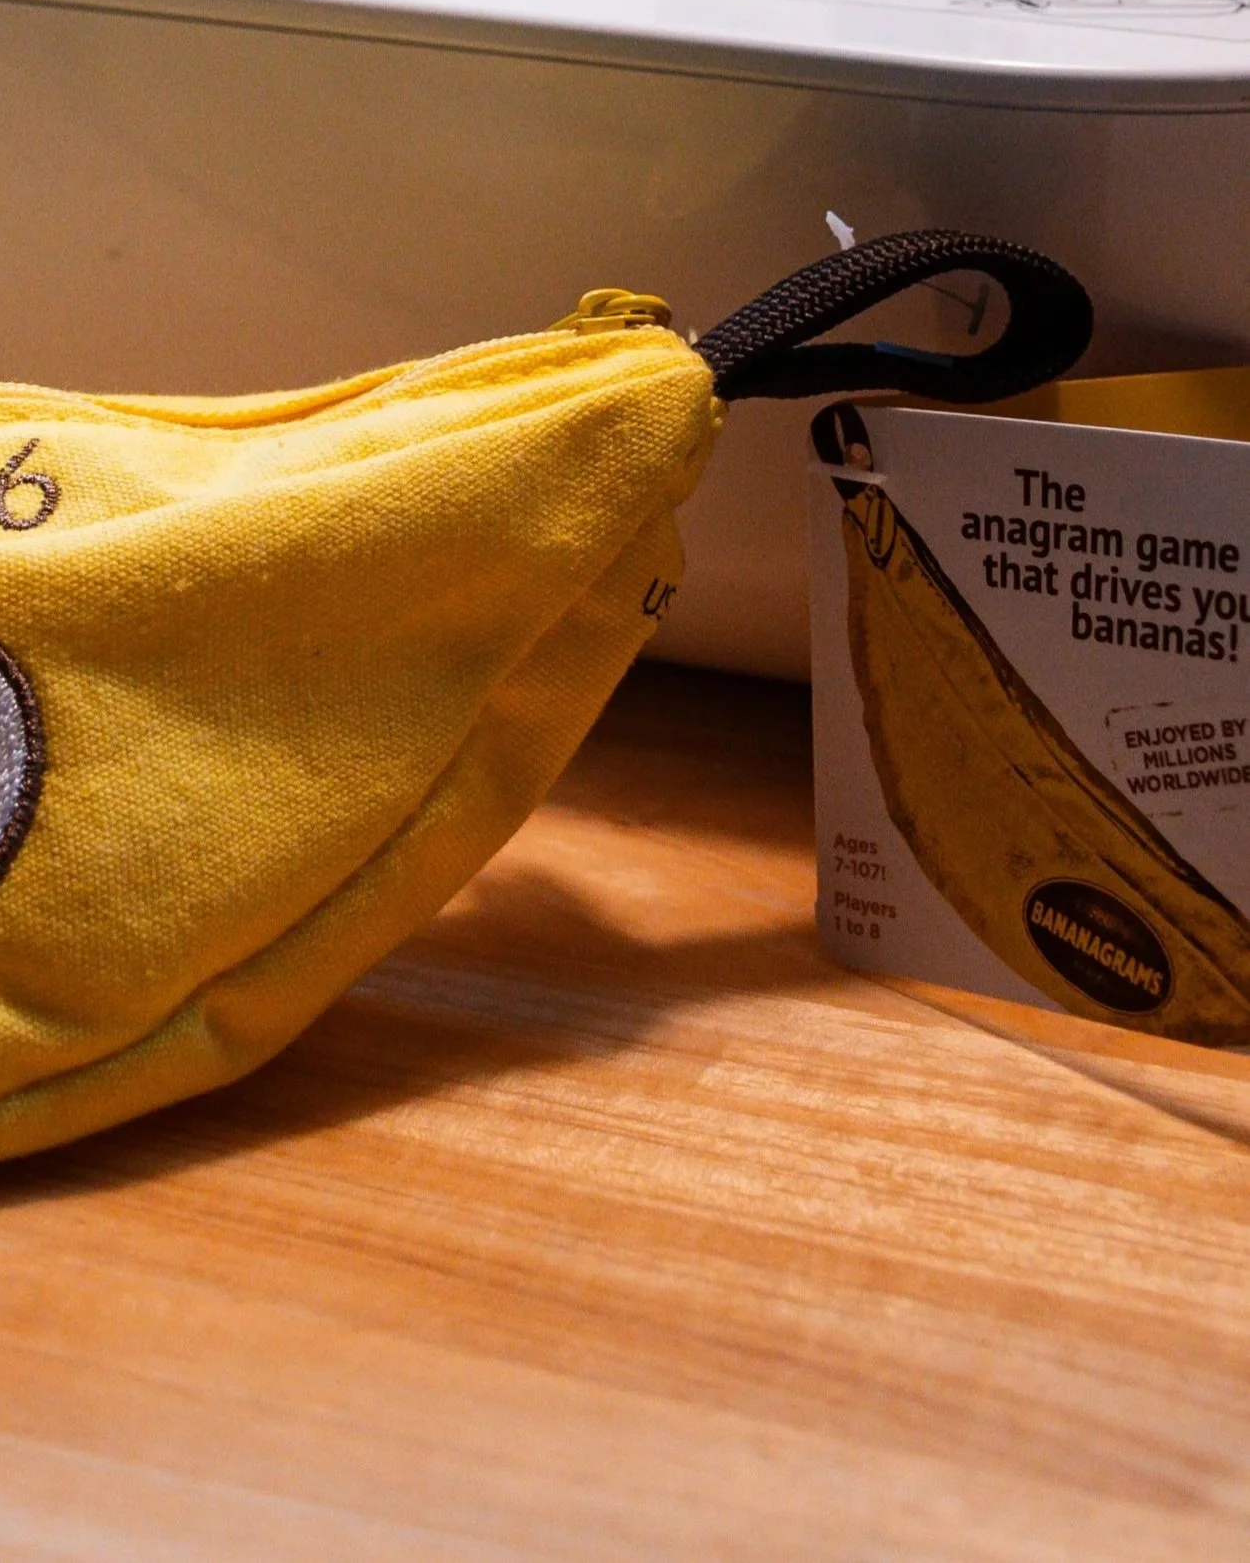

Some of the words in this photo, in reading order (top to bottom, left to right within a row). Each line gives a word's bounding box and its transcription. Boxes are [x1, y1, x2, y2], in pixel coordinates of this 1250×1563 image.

[1013, 468, 1086, 512] The
[961, 512, 1123, 558] anagram
[1136, 533, 1240, 573] game
[983, 552, 1059, 596] that
[1070, 563, 1181, 613] drives
[1071, 601, 1238, 663] bananas!
[1124, 722, 1215, 749] ENJOYED
[1221, 718, 1246, 738] BY
[1143, 743, 1237, 769] MILLIONS
[1127, 765, 1250, 794] WORLDWIDE
[833, 833, 878, 855] Ages
[835, 891, 896, 919] Players
[846, 919, 865, 936] to
[870, 923, 881, 939] 8
[1030, 900, 1164, 996] BANANAGRAMS
